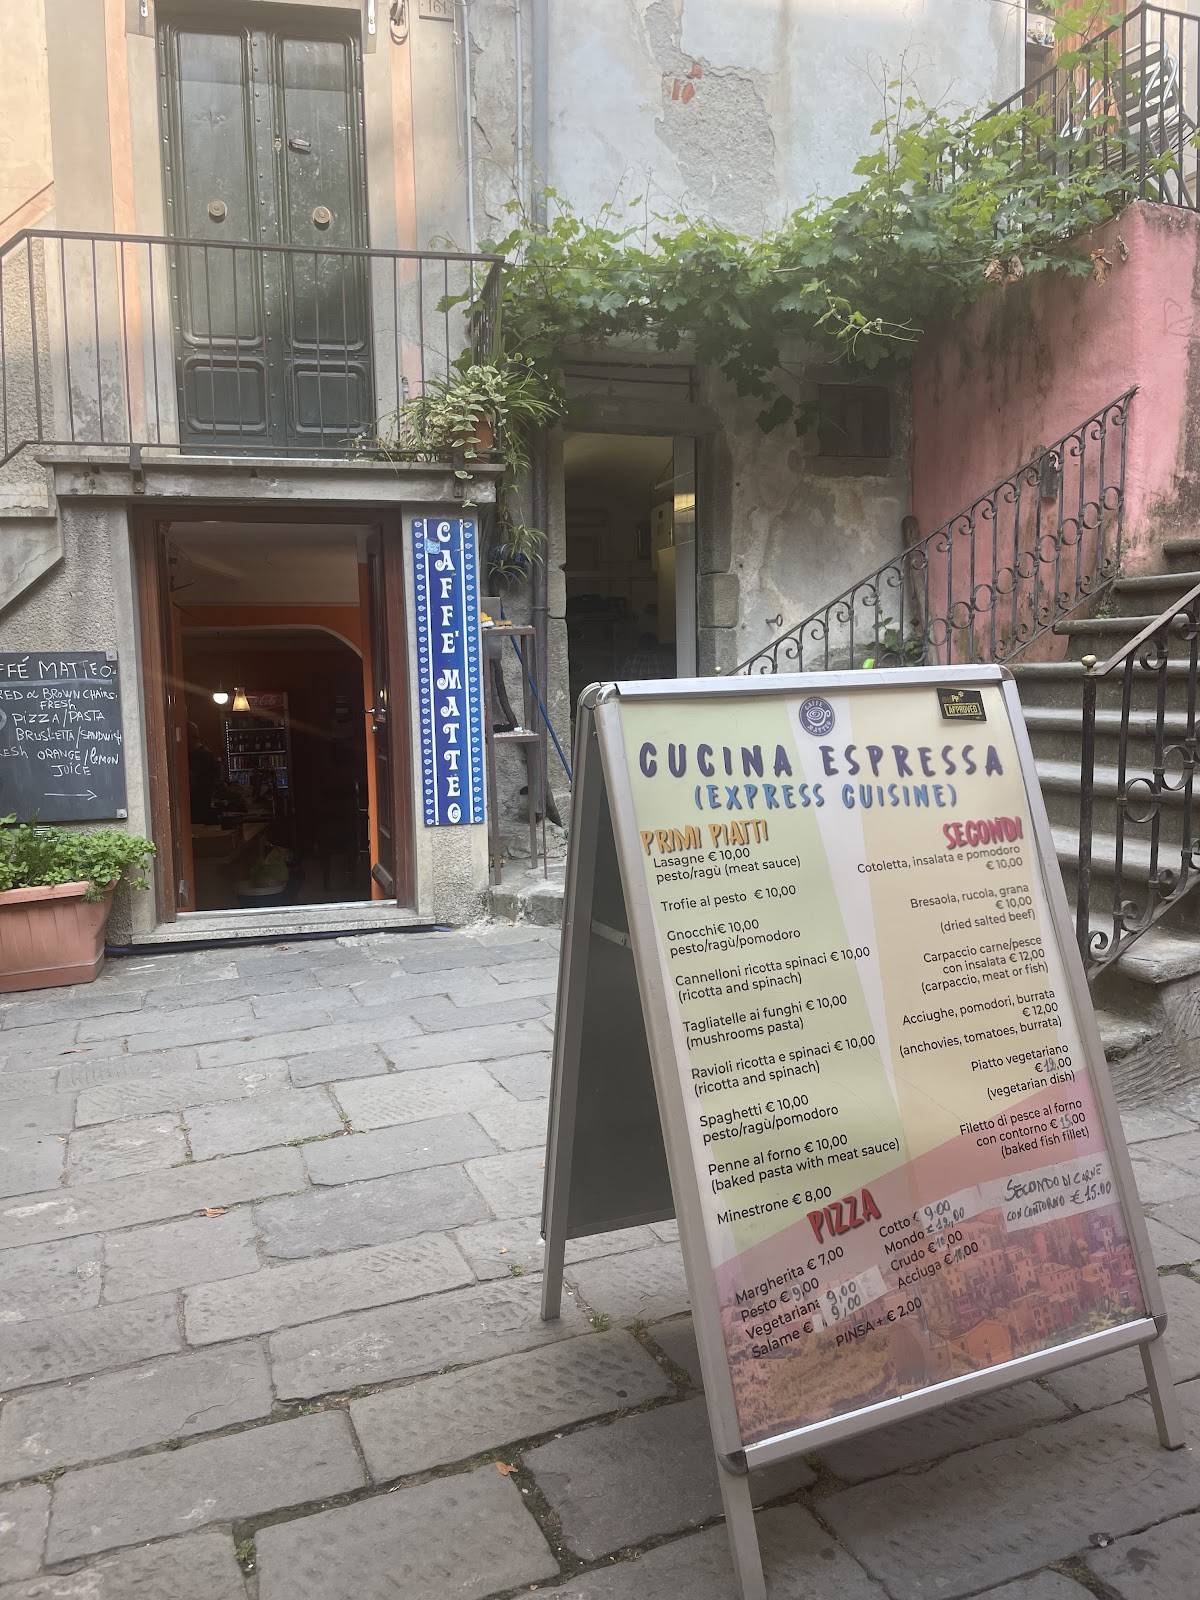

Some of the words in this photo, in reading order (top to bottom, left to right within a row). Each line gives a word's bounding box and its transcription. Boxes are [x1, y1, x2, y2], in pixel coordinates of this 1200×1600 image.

[436, 669, 462, 824] MATTEO
[639, 742, 793, 778] CUCINA
[819, 745, 1003, 778] ESPRESSA
[694, 783, 825, 810] (EXPRESS
[842, 784, 958, 809] CUISINE)
[640, 825, 702, 856] PRIMI
[708, 818, 769, 848] PIATTI
[943, 816, 1024, 850] SECONDI
[654, 854, 704, 868] Lasagne
[708, 851, 717, 861] €
[720, 848, 750, 861] 10,00
[656, 866, 721, 884] pesto/ragù
[725, 862, 759, 876] (meat
[763, 856, 800, 870] sauce)
[858, 860, 910, 874] Cotoletta,
[913, 854, 954, 866] insalata
[966, 845, 1020, 860] pomodoro
[986, 860, 994, 870] €
[996, 857, 1023, 869] 10,00
[661, 899, 697, 911] Trofie
[700, 896, 710, 908] al
[714, 893, 747, 907] pesto
[754, 889, 763, 899] €
[766, 885, 796, 898] 10,00
[910, 894, 959, 908] Bresaola,
[962, 888, 997, 901] rucola,
[1000, 883, 1029, 897] grana
[995, 900, 1004, 910] €
[1006, 896, 1032, 909] 10,00
[728, 919, 759, 932] 10,00
[940, 918, 972, 934] (dried
[975, 913, 1006, 927] salted
[1009, 910, 1036, 924] beef)
[670, 930, 800, 958] pesto/ragù/pomodoro
[924, 946, 977, 964] Carpaccio
[980, 936, 1042, 955] carne/pesce
[676, 967, 741, 986] Cannelloni
[745, 961, 782, 976] ricotta
[785, 953, 827, 970] spinaci
[830, 951, 839, 961] €
[841, 947, 870, 960] 10,00
[943, 965, 963, 974] con
[965, 957, 1007, 971] insalata
[1009, 953, 1017, 963] €
[1019, 948, 1045, 962] 12,00
[678, 984, 723, 1004] (ricotta
[726, 978, 749, 993] and
[752, 972, 802, 990] spinach)
[921, 975, 980, 994] (carpaccio,
[983, 970, 1010, 982] meat
[1012, 968, 1022, 977] or
[1025, 963, 1049, 977] fish)
[683, 1012, 746, 1033] Tagliatelle
[750, 1009, 760, 1021] ai
[763, 1002, 802, 1019] funghi
[806, 1000, 815, 1011] €
[817, 995, 847, 1009] 10,00
[902, 1008, 958, 1026] Acciughe,
[960, 997, 1015, 1016] pomodori,
[1017, 990, 1055, 1004] burrata
[1023, 1007, 1030, 1017] €
[1032, 1002, 1058, 1016] 12,00
[686, 1026, 764, 1050] (mushrooms
[768, 1016, 804, 1036] pasta)
[900, 1037, 962, 1058] (anchovies,
[964, 1026, 1018, 1043] tomatoes,
[1020, 1016, 1062, 1033] burrata)
[692, 1061, 733, 1079] Ravioli
[736, 1055, 775, 1071] ricotta
[779, 1054, 786, 1062] e
[789, 1043, 831, 1061] spinaci
[834, 1041, 843, 1051] €
[845, 1034, 876, 1049] 10,00
[971, 1056, 1004, 1071] Piatto
[1006, 1044, 1069, 1065] vegetariano
[1035, 1062, 1043, 1072] €
[694, 1076, 739, 1098] (ricotta
[743, 1071, 766, 1086] and
[769, 1060, 820, 1082] spinach)
[987, 1078, 1047, 1100] (vegetarian
[1050, 1070, 1075, 1085] dish)
[700, 1103, 762, 1130] Spaghetti
[765, 1101, 775, 1112] €
[777, 1094, 809, 1110] 10,00
[703, 1105, 839, 1145] pesto/ragù/pomodoro
[960, 1119, 995, 1135] Filetto
[998, 1114, 1007, 1127] di
[1010, 1109, 1041, 1126] pesce
[1043, 1105, 1052, 1116] al
[1054, 1100, 1082, 1113] forno
[976, 1137, 996, 1147] con
[999, 1124, 1047, 1142] contorno
[1050, 1118, 1058, 1129] €
[1001, 1139, 1038, 1159] (baked
[1040, 1132, 1061, 1147] fish
[1063, 1125, 1089, 1141] fillet)
[709, 1156, 749, 1175] Penne
[753, 1152, 764, 1166] al
[768, 1145, 801, 1163] forno
[804, 1142, 814, 1153] €
[816, 1134, 848, 1151] 10,00
[711, 1171, 755, 1194] (baked
[759, 1166, 793, 1183] pasta
[796, 1156, 824, 1172] with
[828, 1151, 859, 1166] meat
[862, 1138, 900, 1157] sauce)
[1062, 1174, 1070, 1186] DI
[717, 1198, 789, 1225] Minestrone
[792, 1193, 802, 1204] €
[805, 1186, 831, 1202] 8,00
[807, 1188, 882, 1244] PIZZA
[1024, 1196, 1065, 1218] CONTORNO
[1070, 1190, 1085, 1204] €
[879, 1219, 910, 1238] Cotto
[884, 1231, 924, 1255] Mondo
[891, 1250, 925, 1271] Crudo
[928, 1242, 936, 1253] €
[898, 1262, 941, 1289] Acciuga
[944, 1254, 952, 1264] €
[735, 1265, 804, 1304] Margherita
[807, 1258, 816, 1270] €
[818, 1246, 844, 1266] 7,00
[740, 1299, 776, 1322] Pesto
[780, 1290, 790, 1303] €
[792, 1277, 819, 1301] 9,00
[836, 1321, 875, 1347] PINSA
[887, 1311, 897, 1322] €
[899, 1297, 922, 1318] 2,00
[752, 1330, 800, 1358] Salame
[803, 1321, 813, 1333] €
